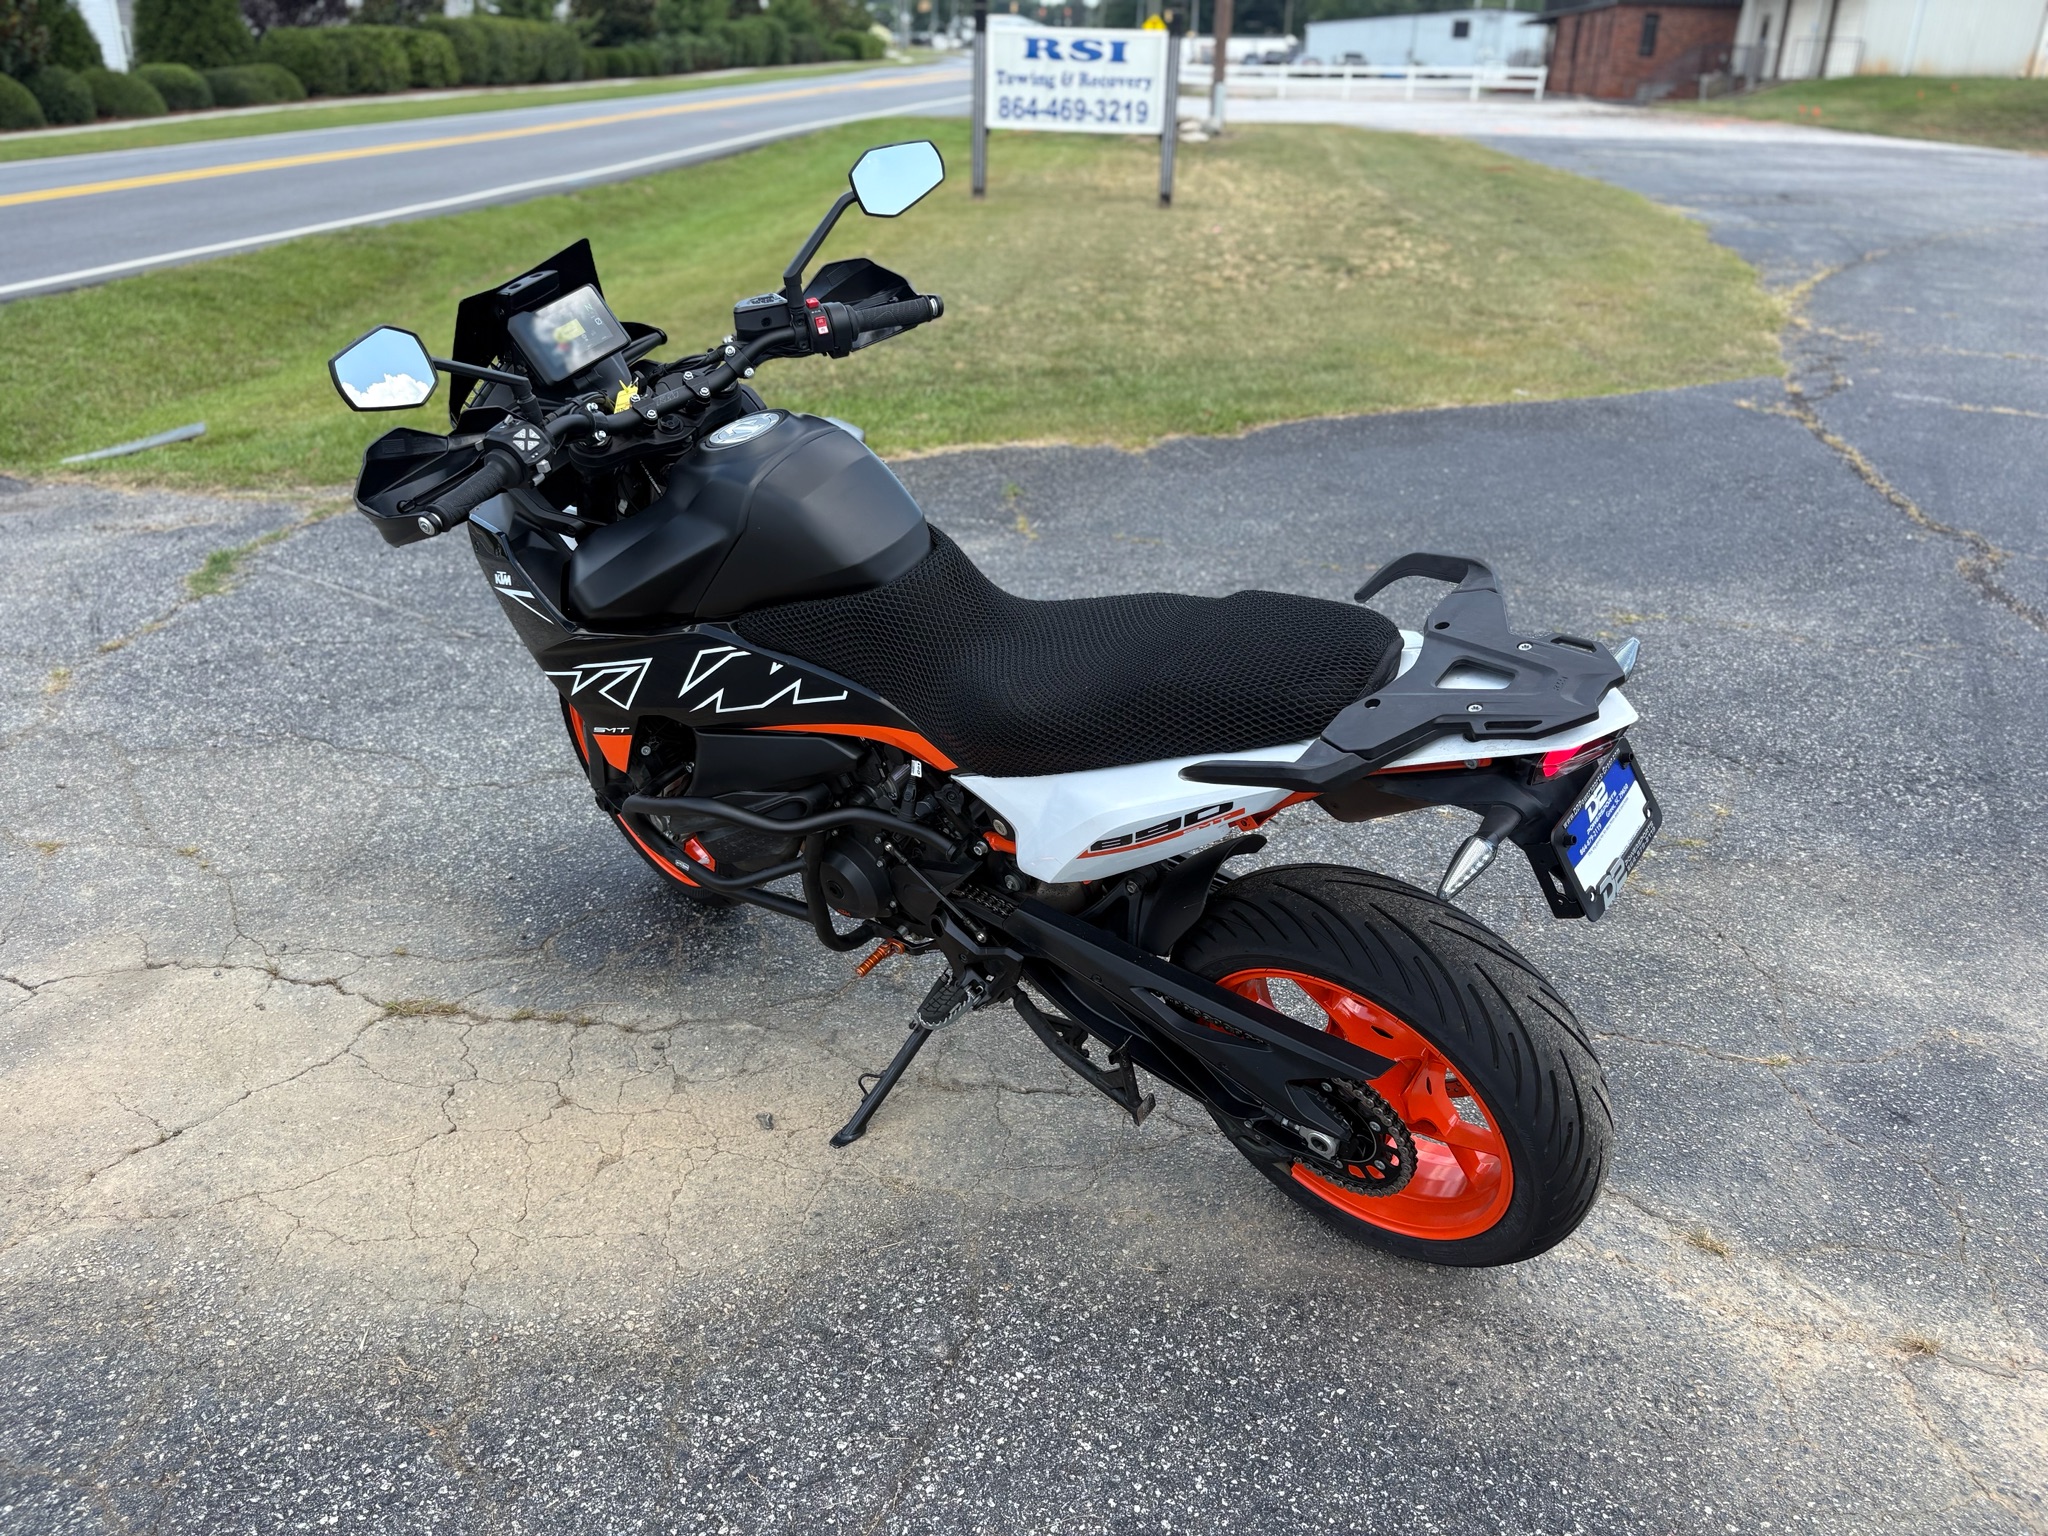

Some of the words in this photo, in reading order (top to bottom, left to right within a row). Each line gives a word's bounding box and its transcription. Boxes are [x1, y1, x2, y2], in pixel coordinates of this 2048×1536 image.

[1024, 37, 1128, 63] RSI
[996, 69, 1055, 89] Towing
[1061, 71, 1075, 88] &
[1079, 70, 1152, 92] Recovery
[998, 96, 1149, 124] 864-469-3219
[494, 570, 512, 586] KTM
[593, 726, 631, 734] SMT
[1584, 781, 1609, 824] D2
[1586, 789, 1617, 835] POWERSPORTS
[1090, 801, 1234, 852] 890
[1600, 857, 1628, 910] D2
